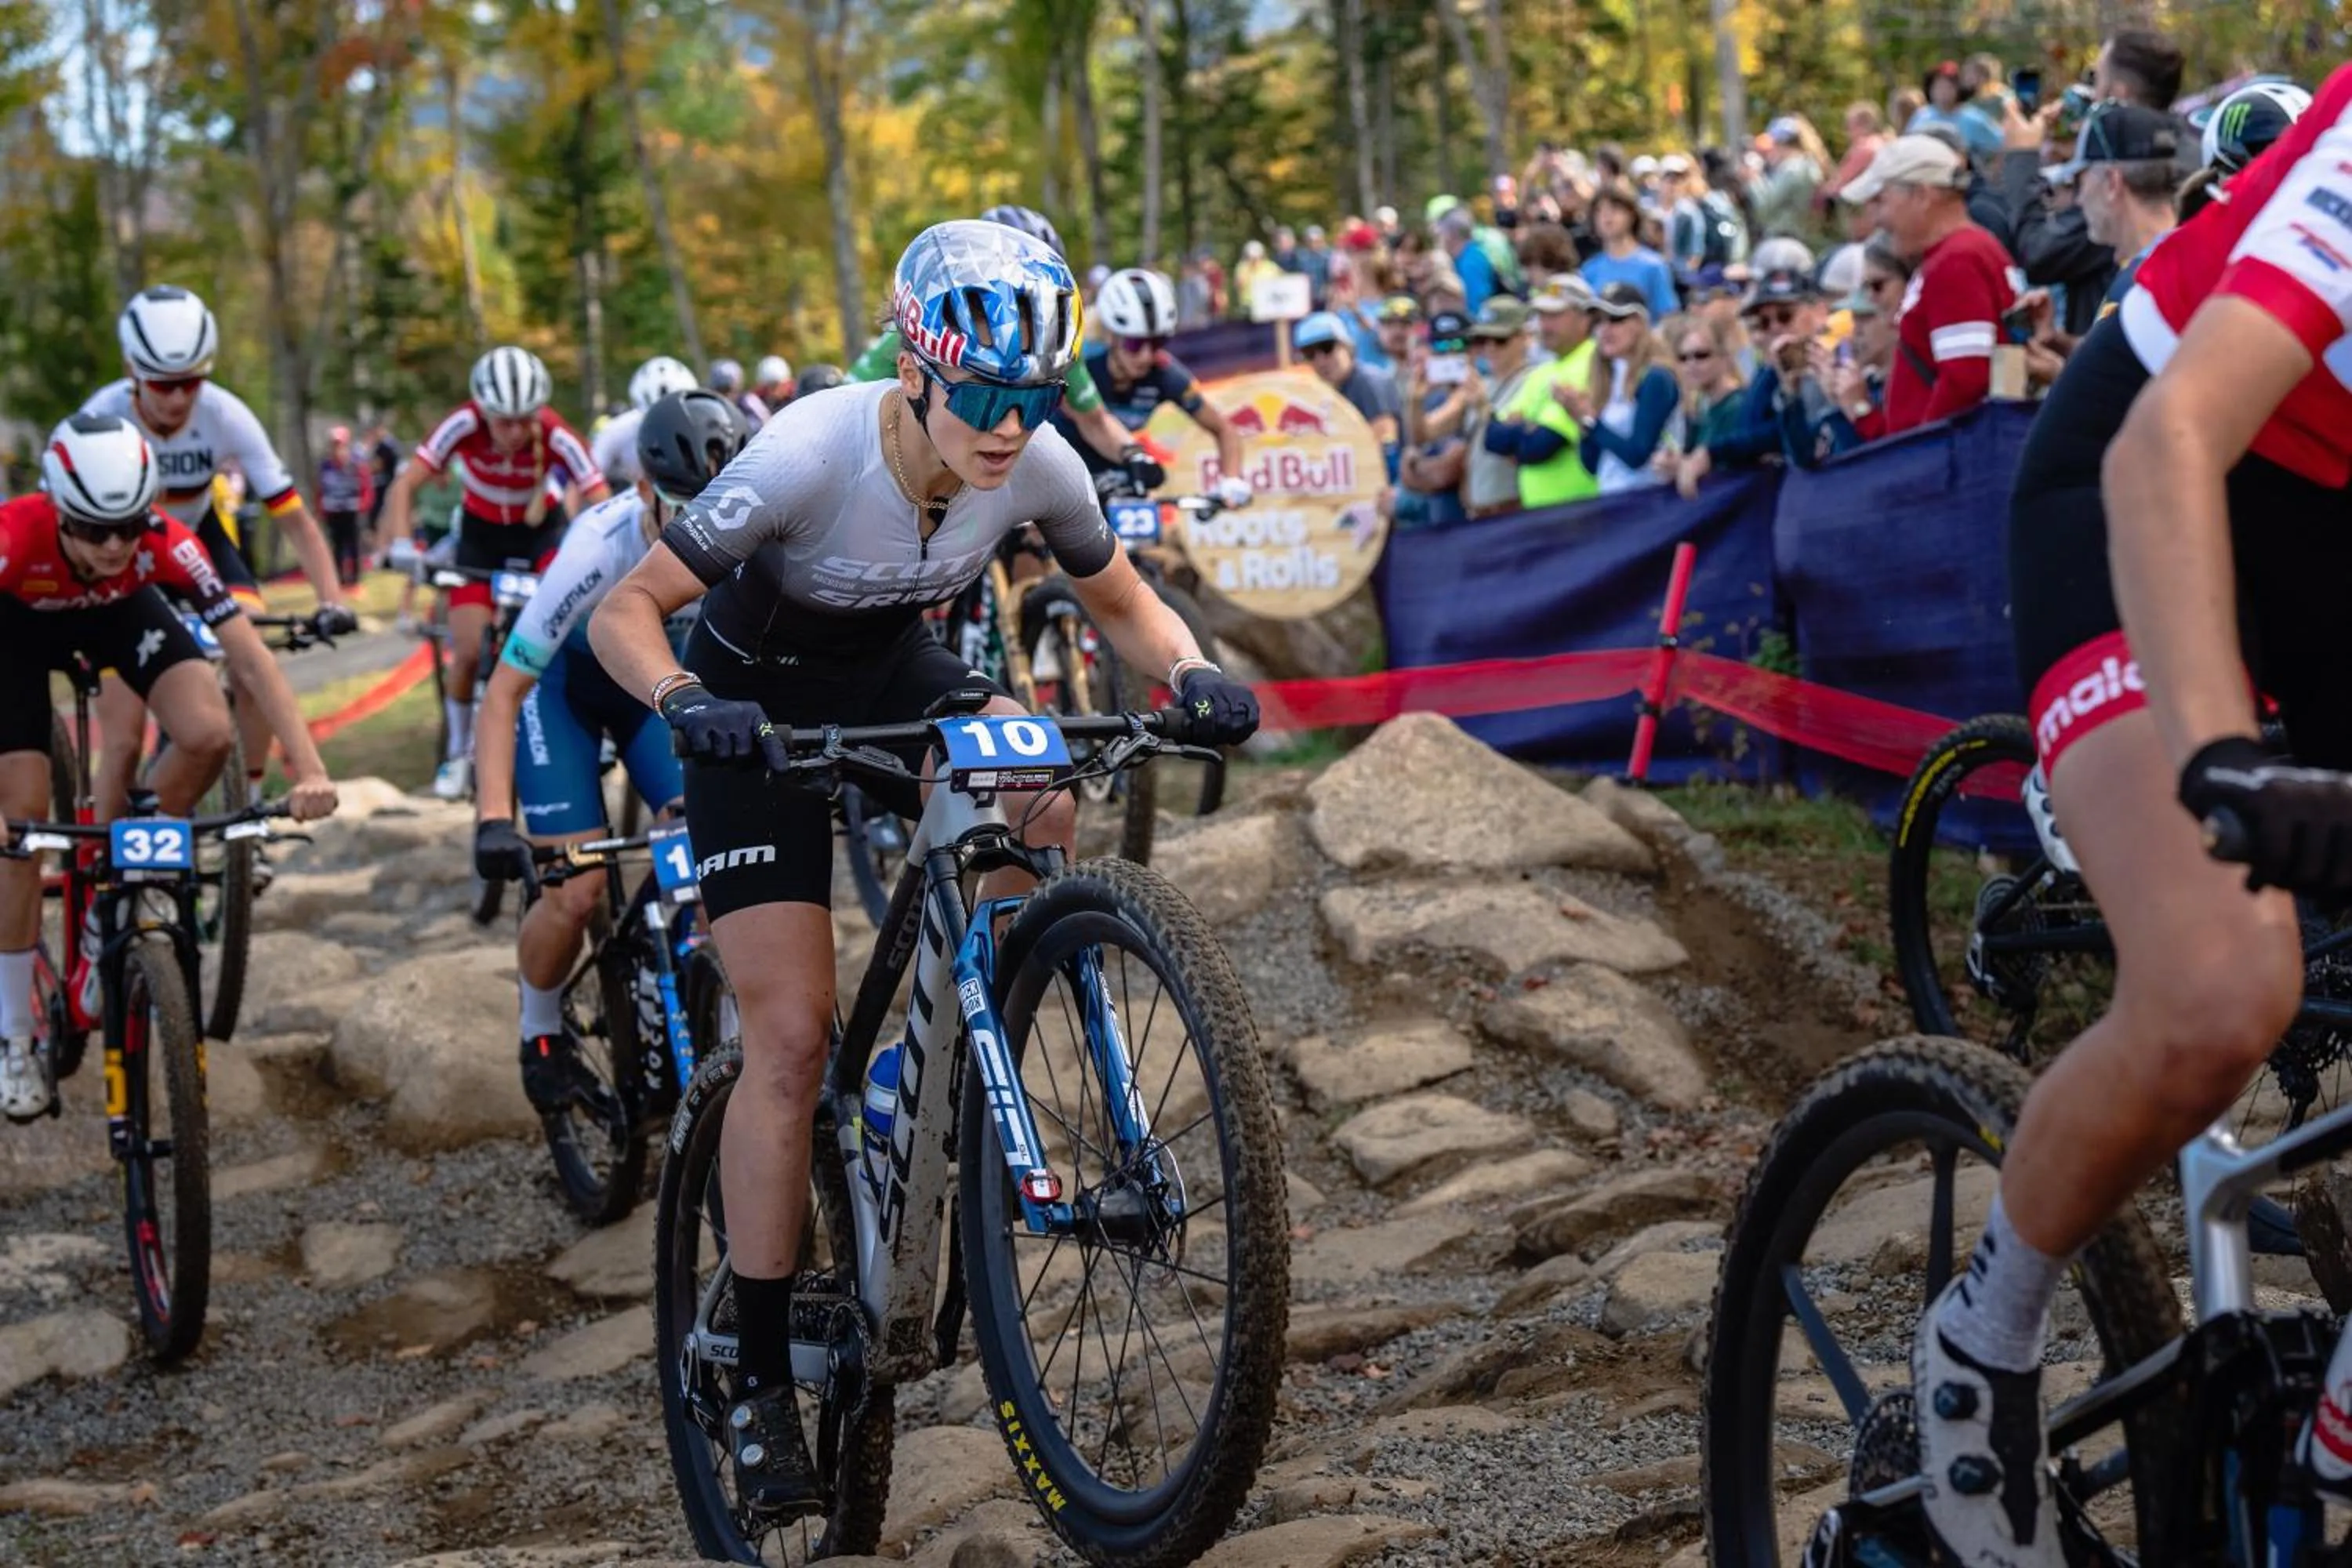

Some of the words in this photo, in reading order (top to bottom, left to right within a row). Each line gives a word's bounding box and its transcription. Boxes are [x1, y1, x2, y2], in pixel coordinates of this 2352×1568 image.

[902, 294, 968, 368] Bull
[1200, 451, 1272, 492] Rd
[1279, 450, 1351, 489] Bull
[1116, 507, 1156, 537] 23
[174, 539, 225, 598] BMC
[1240, 547, 1340, 590] Rolls
[960, 720, 1049, 757] 10
[122, 828, 183, 862] 32
[1000, 1399, 1067, 1512] MAXXIS
